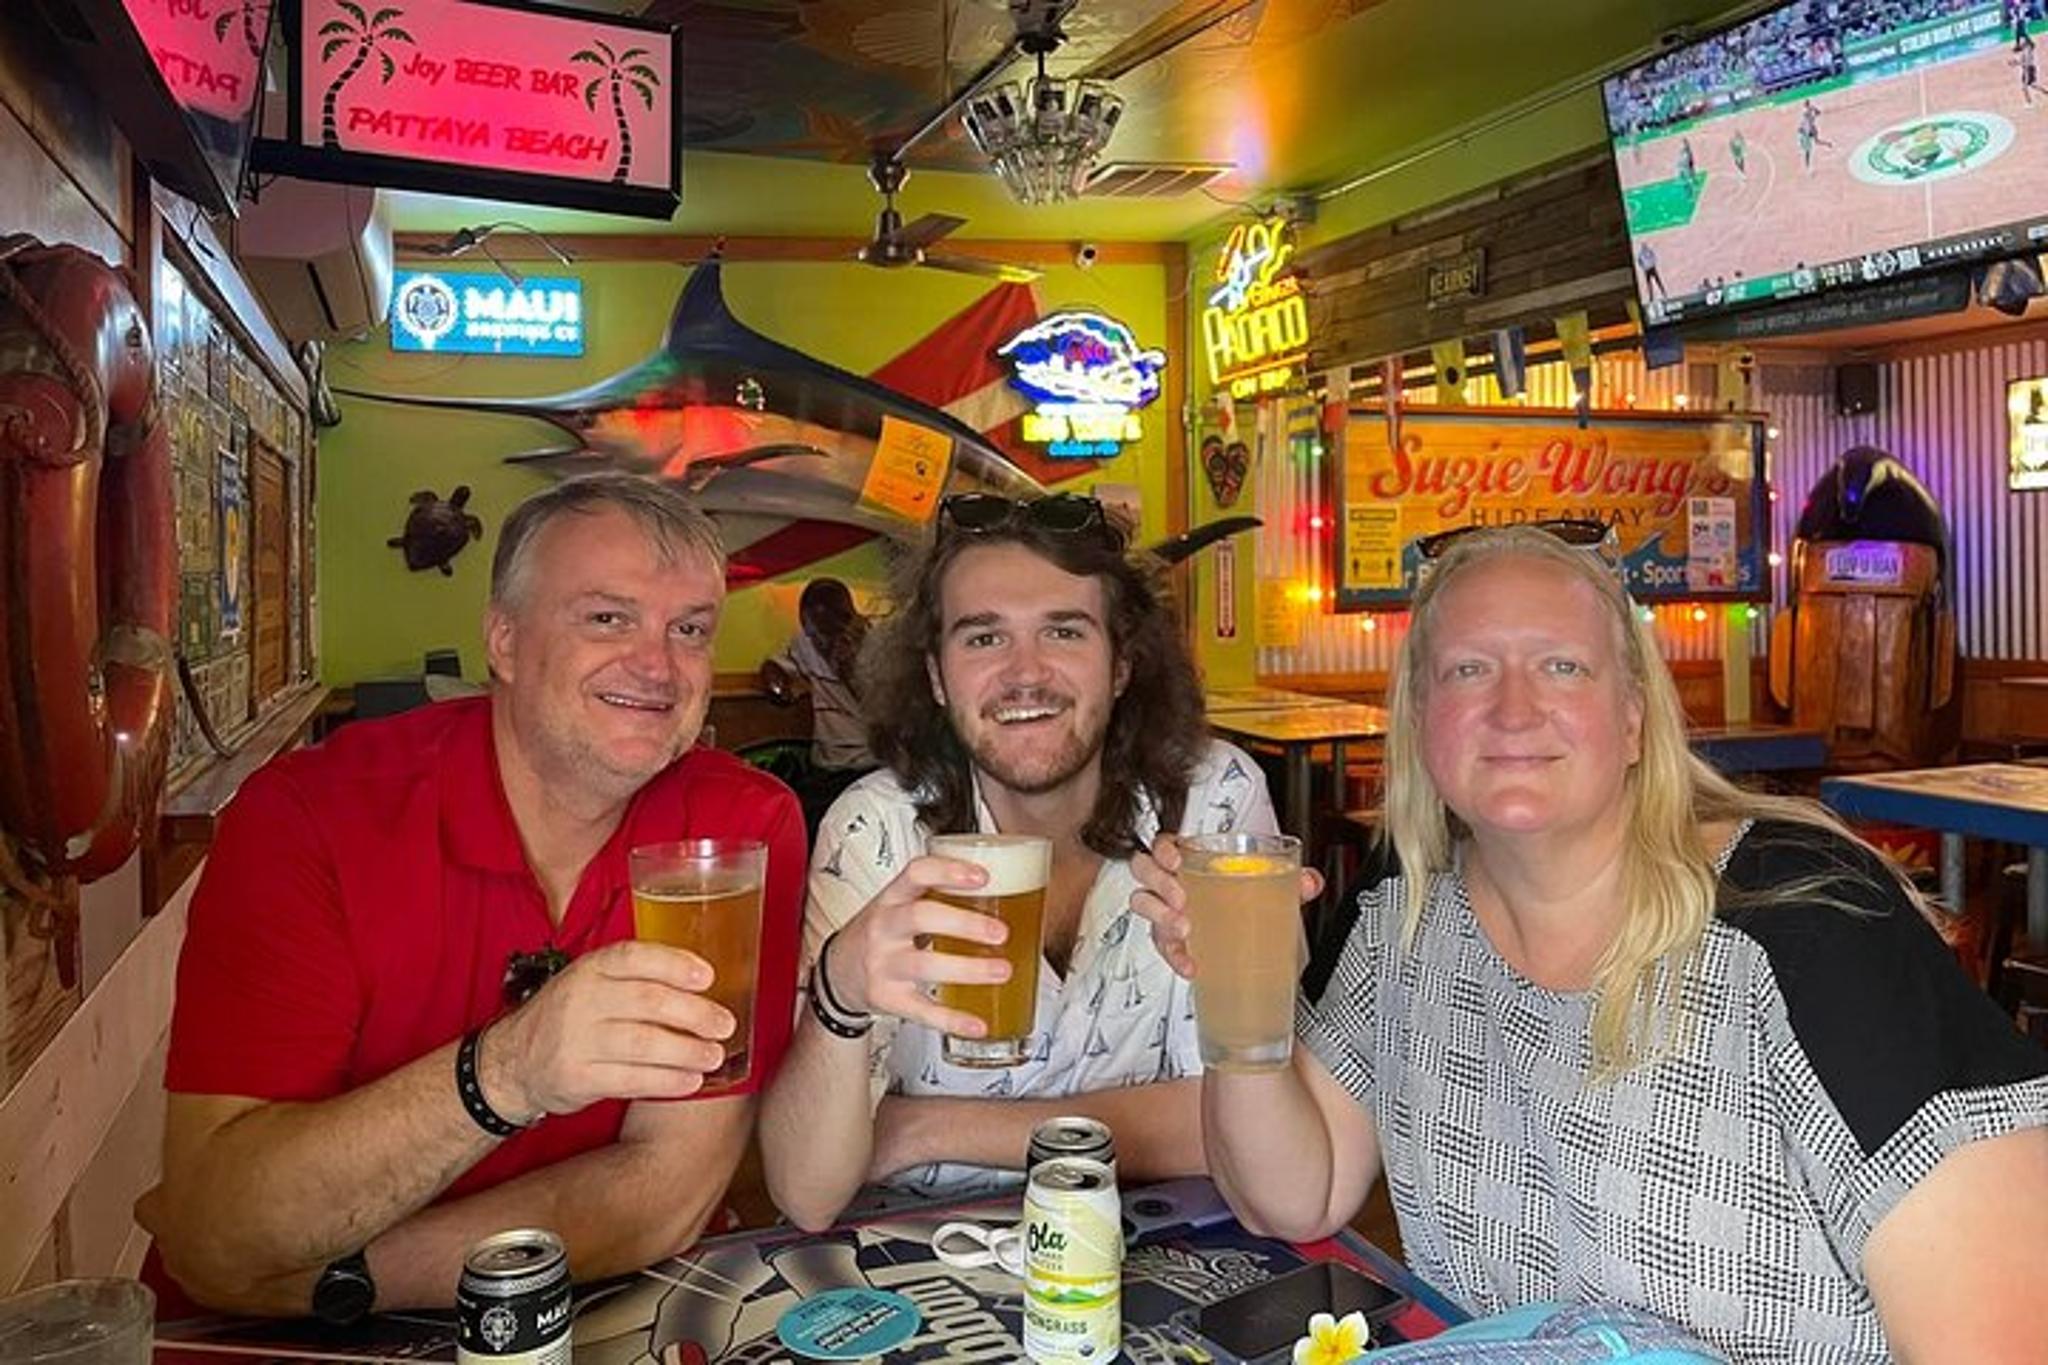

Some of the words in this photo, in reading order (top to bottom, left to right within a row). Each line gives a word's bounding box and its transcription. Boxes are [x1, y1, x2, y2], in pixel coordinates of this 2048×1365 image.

[403, 53, 447, 86] Joy
[454, 58, 521, 91] BEER
[530, 69, 579, 99] BAR
[348, 107, 491, 148] PATTAYA
[465, 287, 579, 322] MAUI
[1370, 433, 1533, 518] Suzie
[1470, 507, 1646, 527] HIDEAWAY
[1028, 1221, 1068, 1252] Ola
